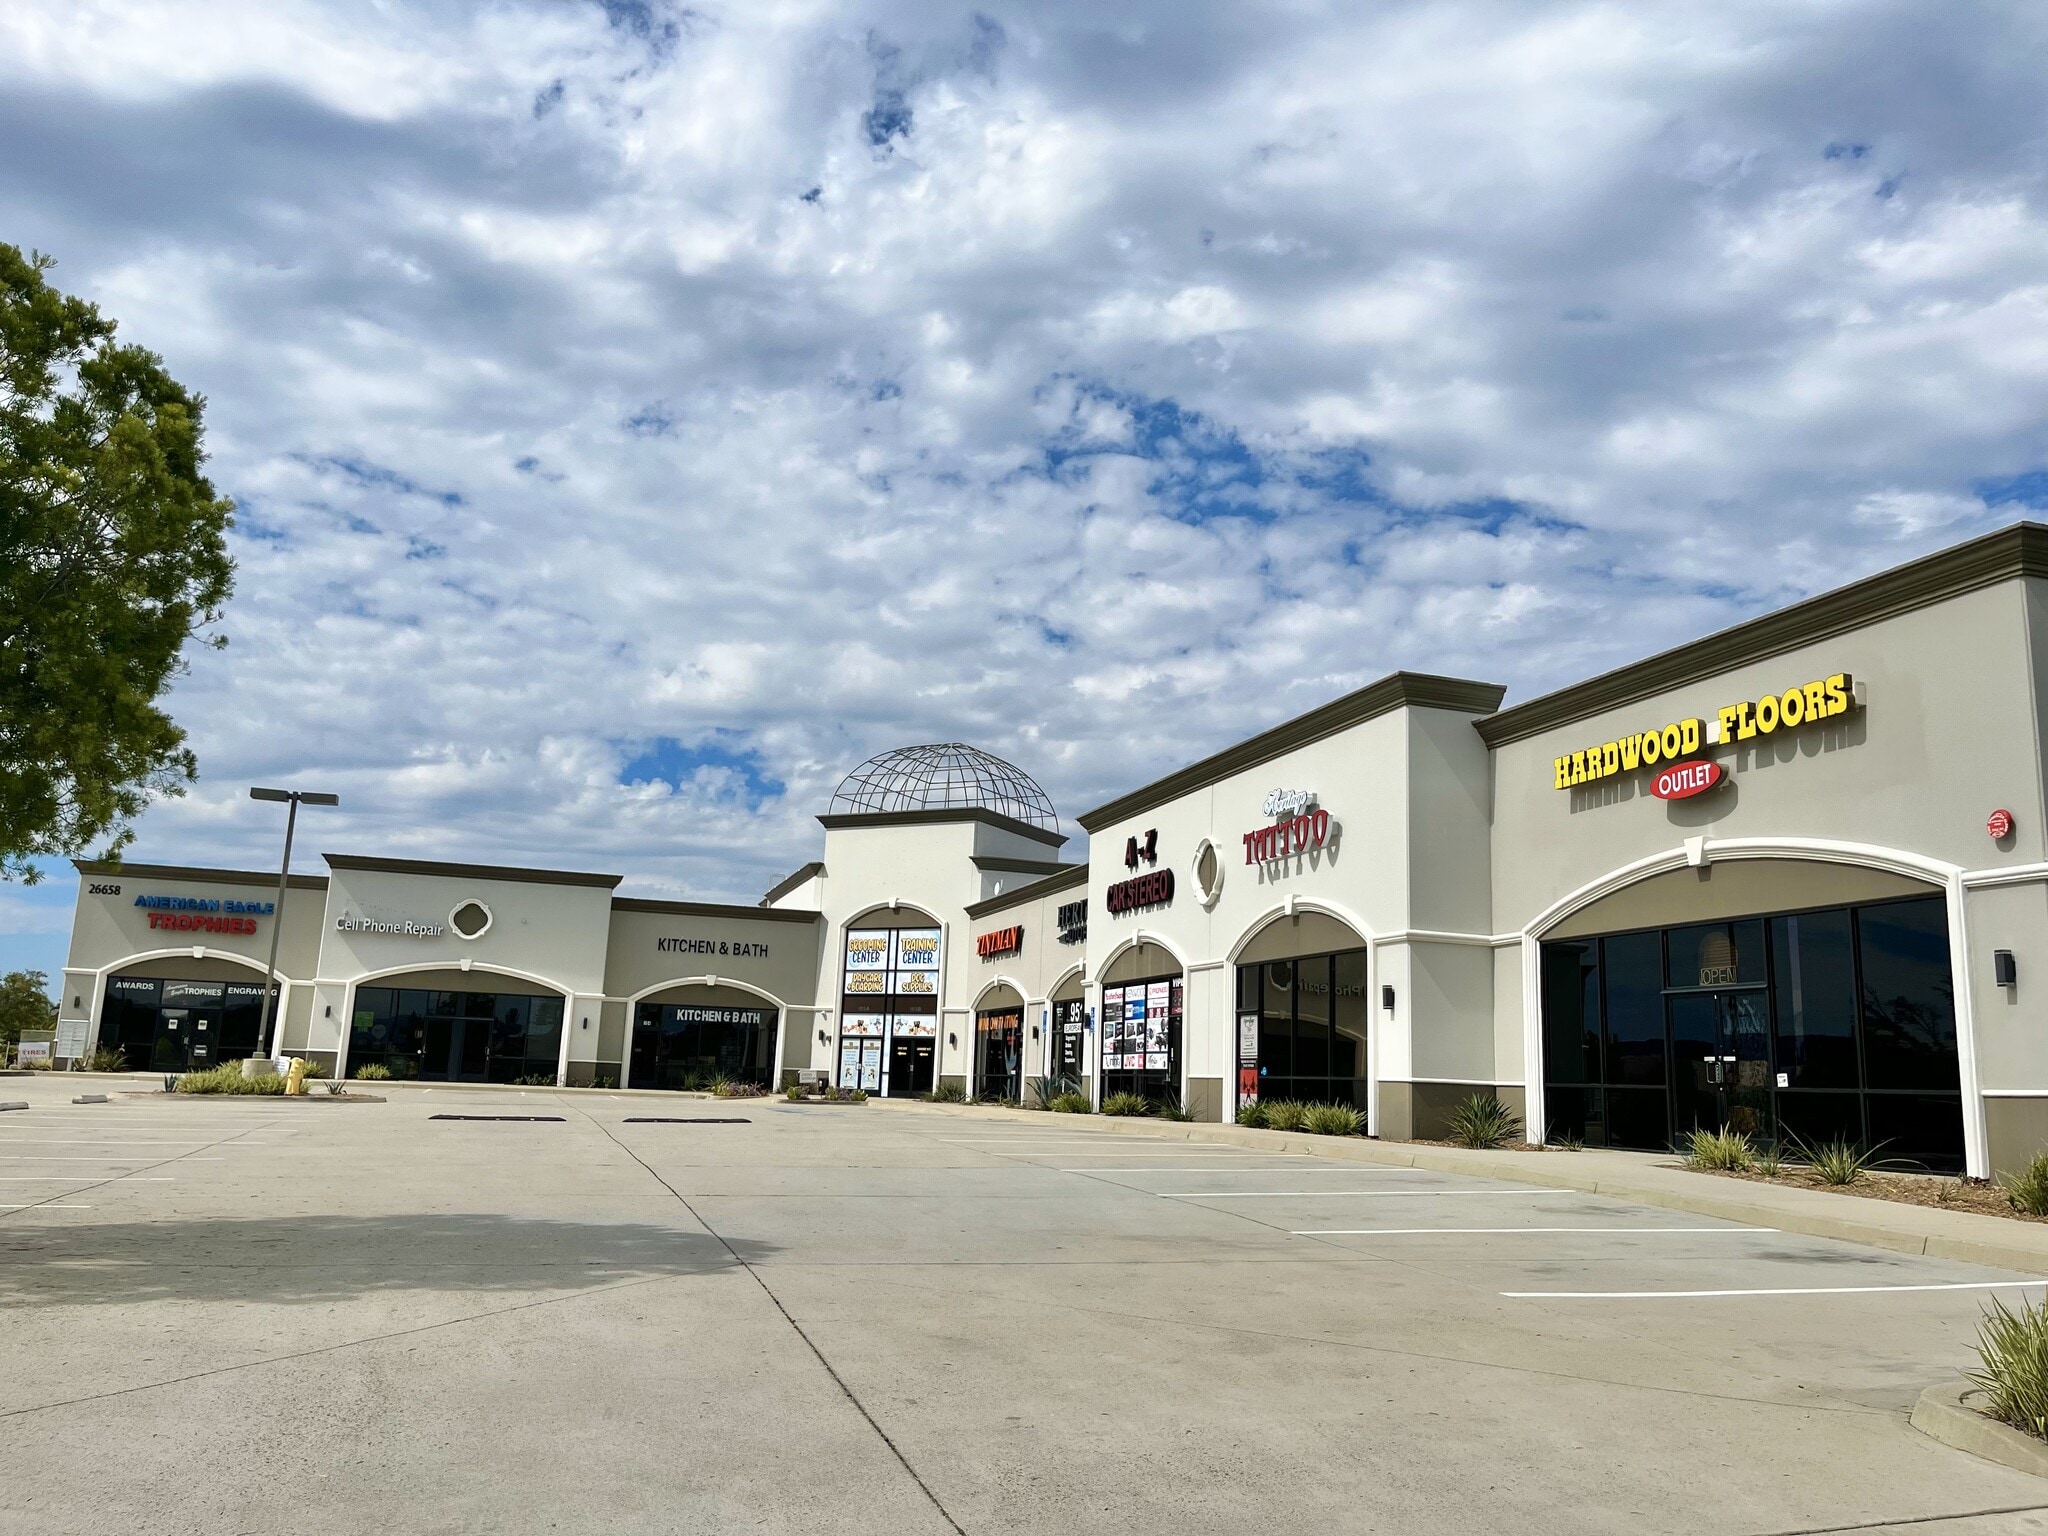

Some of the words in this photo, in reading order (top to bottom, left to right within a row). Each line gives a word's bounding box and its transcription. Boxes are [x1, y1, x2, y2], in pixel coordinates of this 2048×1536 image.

[1554, 718, 1699, 790] HARDWOOD
[1718, 673, 1847, 744] FLOORS
[1658, 764, 1712, 795] OUTLET
[1243, 810, 1329, 866] TATTOO
[1125, 828, 1158, 866] A-Z
[88, 883, 121, 896] 26658
[1107, 883, 1125, 912] CAR
[1127, 868, 1168, 908] STEREO
[134, 895, 220, 912] AMERICAN
[223, 900, 275, 915] EAGLE
[147, 913, 257, 935] TROPHIES
[335, 917, 359, 931] Cell
[362, 918, 401, 933] Phone
[405, 920, 444, 939] Repair
[657, 938, 716, 955] KITCHEN
[718, 941, 729, 956] &
[732, 943, 769, 958] BATH
[849, 938, 887, 952] GROOMING
[901, 937, 938, 952] TRAINING
[976, 925, 1021, 957] TINTMAN
[852, 950, 880, 963] CENTER
[903, 950, 933, 964] CENTER
[852, 972, 883, 983] DAYCARE
[910, 972, 925, 983] DOG
[1703, 968, 1735, 985] OPEN
[115, 981, 154, 990] AWARDS
[185, 987, 222, 996] TROPHIES
[227, 986, 277, 997] ENGRAVIG
[902, 981, 933, 993] SUPPLIES
[676, 1009, 722, 1022] KITCHEN
[723, 1012, 731, 1022] &
[732, 1012, 760, 1024] BATH
